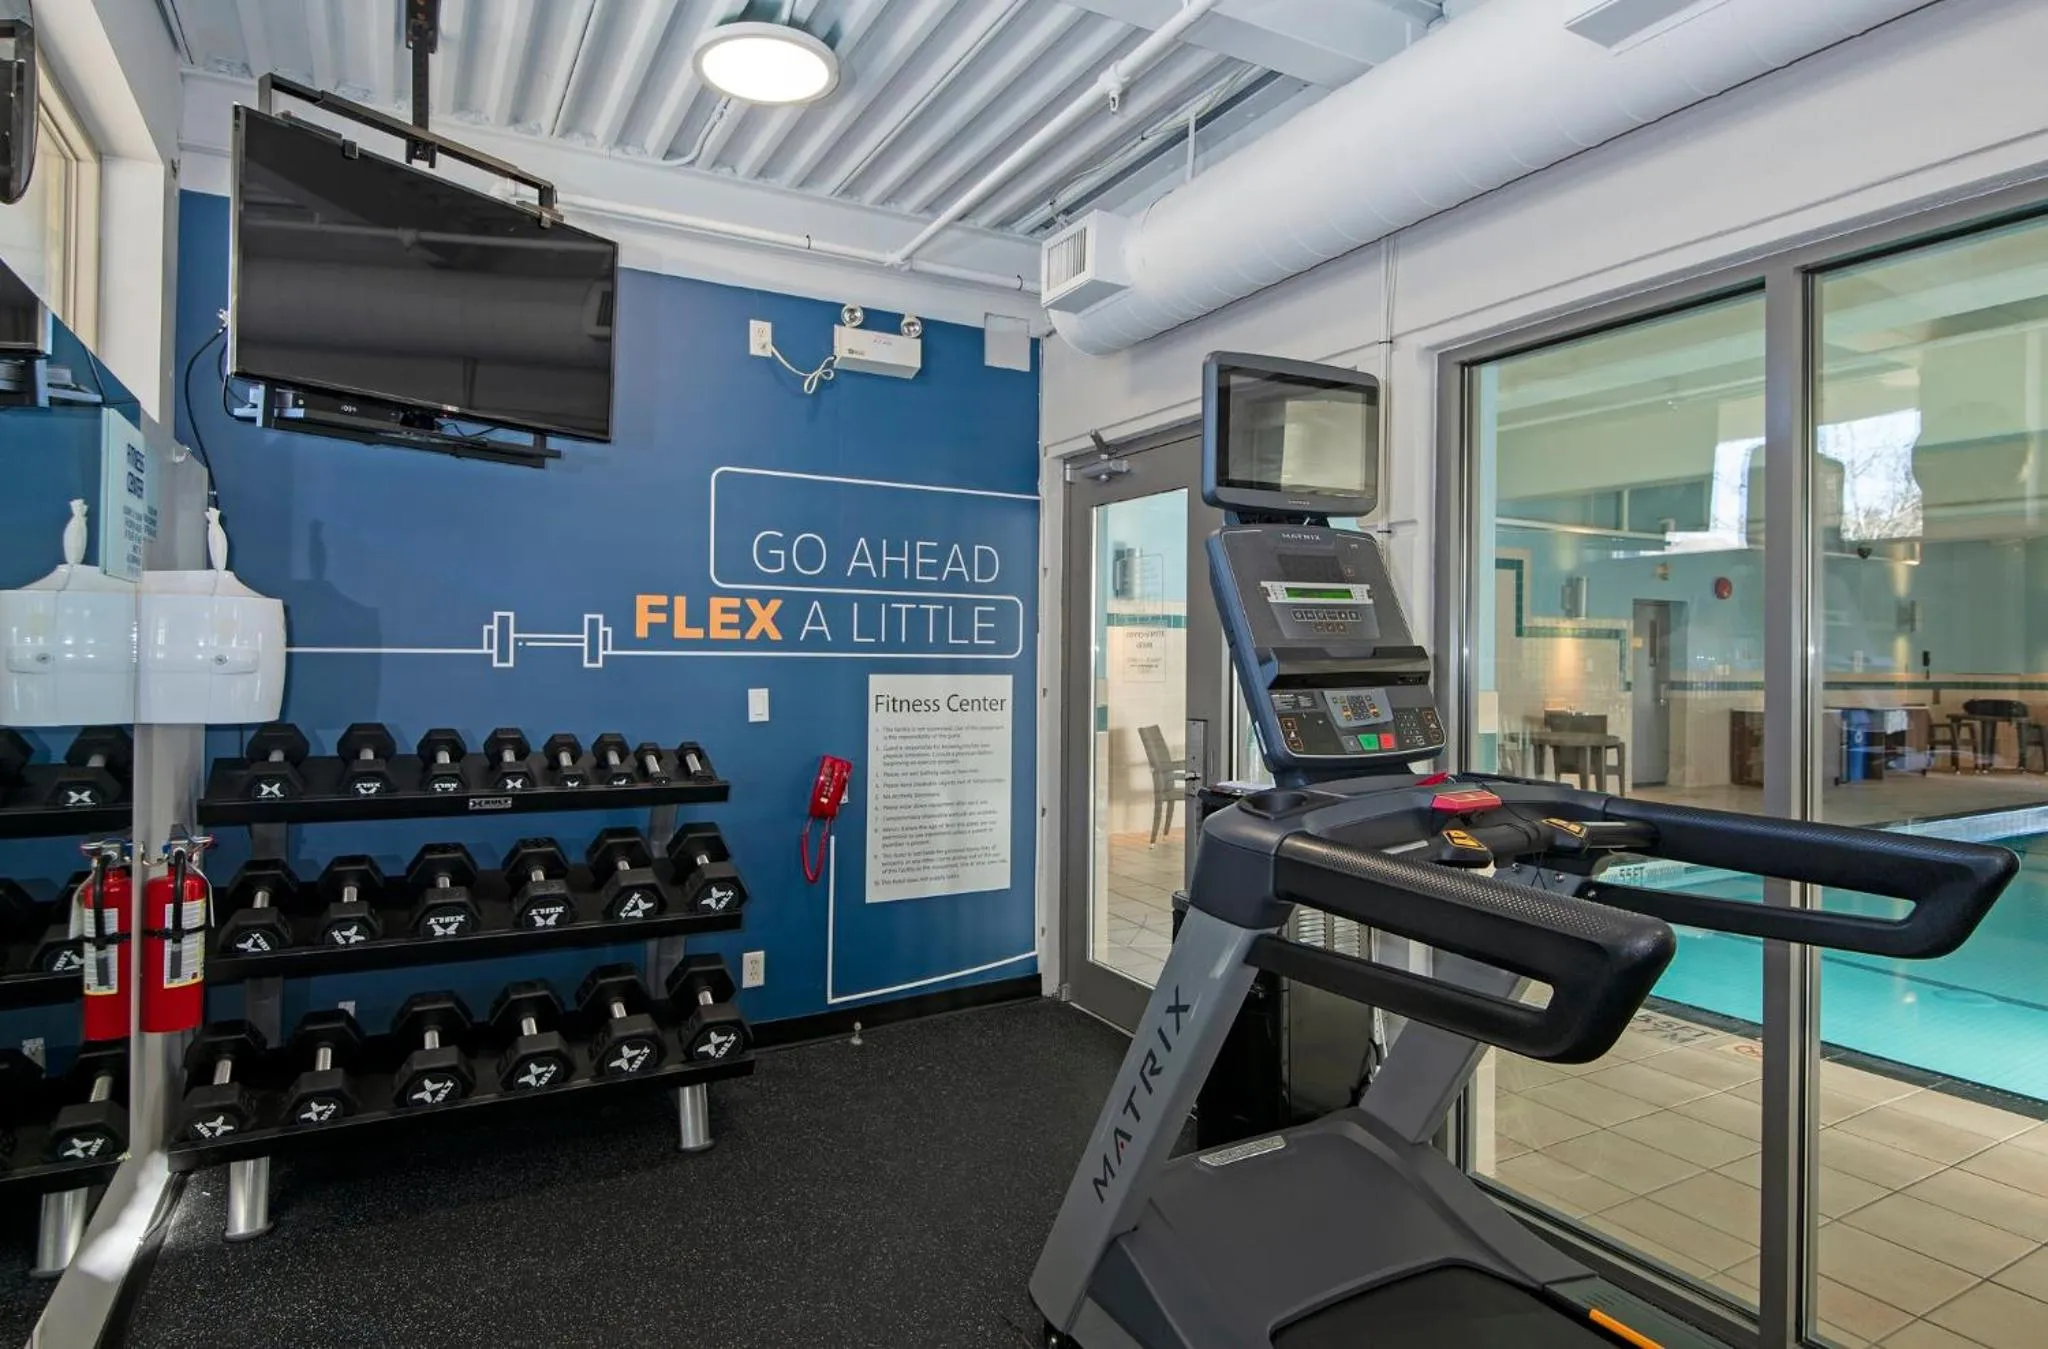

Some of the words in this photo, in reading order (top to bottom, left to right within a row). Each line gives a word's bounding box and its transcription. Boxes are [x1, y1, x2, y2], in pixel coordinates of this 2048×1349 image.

[752, 530, 827, 575] GO
[846, 537, 1000, 584] AHEAD
[635, 594, 783, 642] FLEX
[799, 600, 833, 643] A
[852, 602, 997, 645] LITTLE
[874, 693, 941, 714] Fitness
[946, 693, 1007, 713] Center
[1092, 983, 1191, 1204] MATRIX
